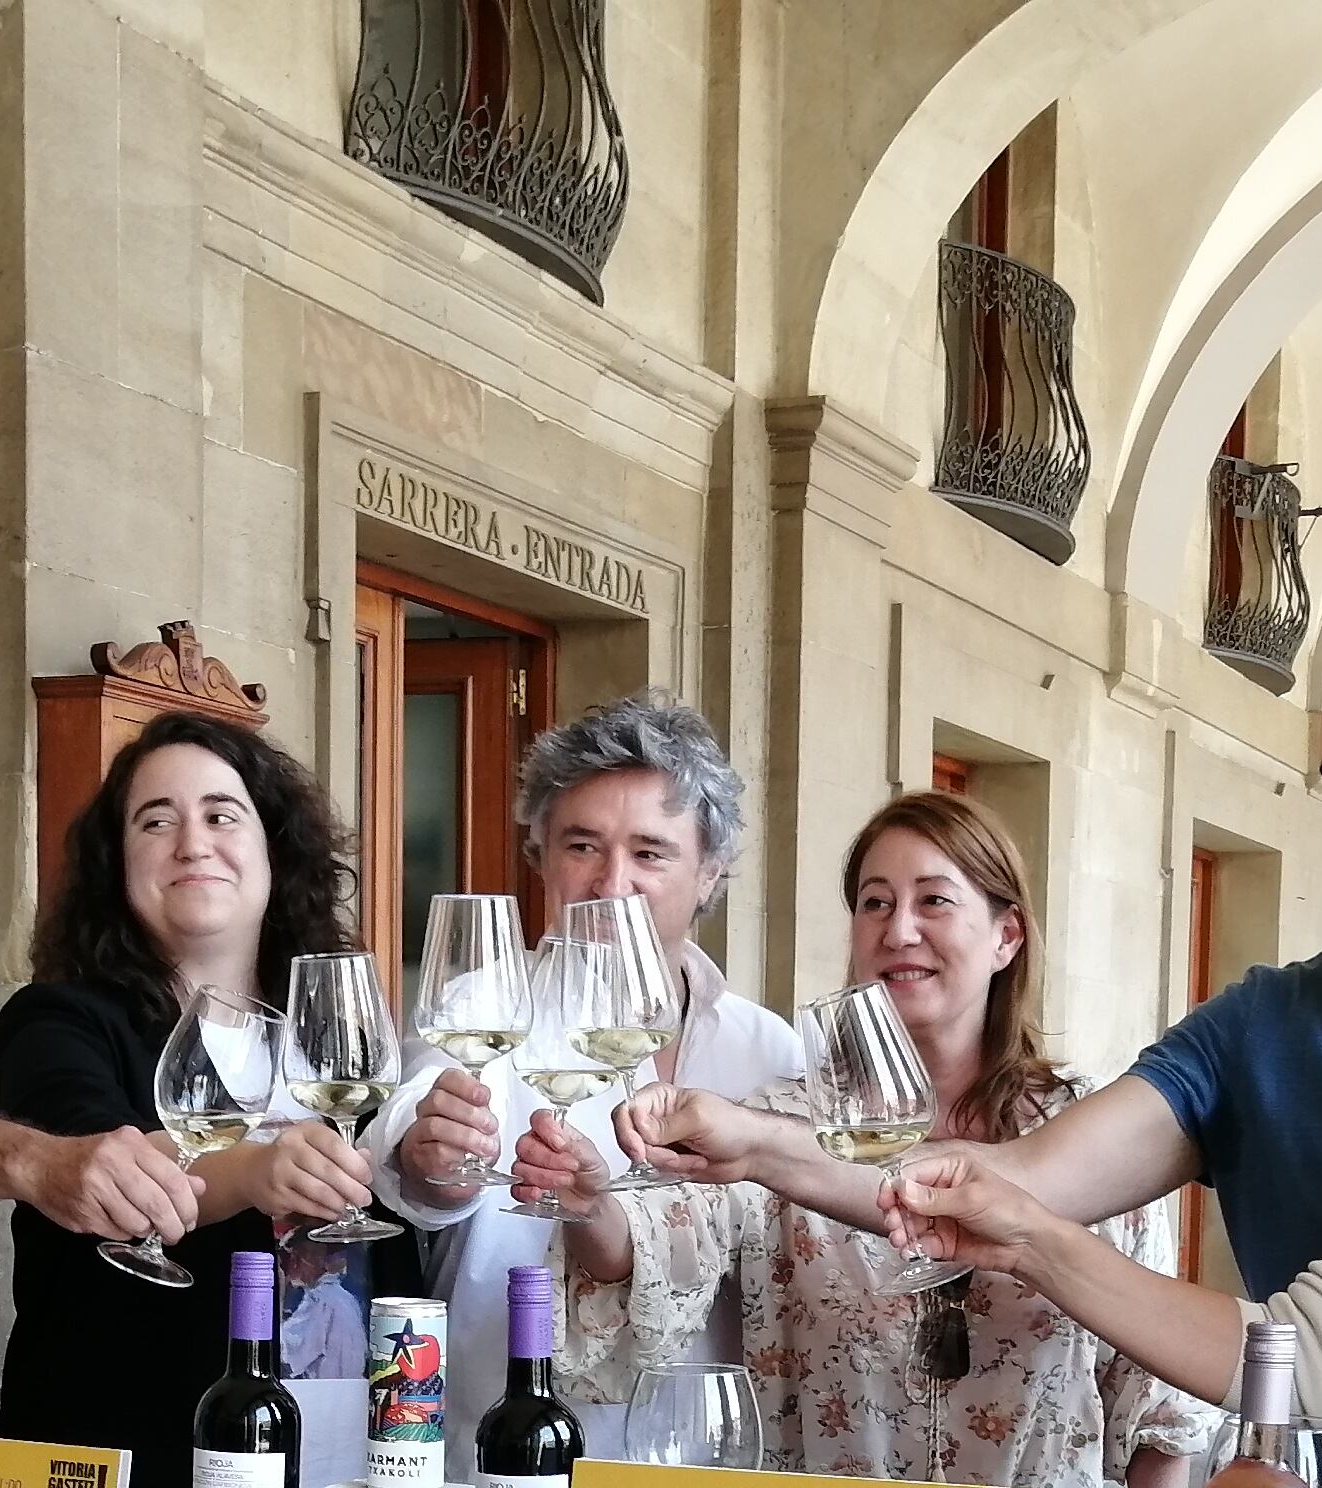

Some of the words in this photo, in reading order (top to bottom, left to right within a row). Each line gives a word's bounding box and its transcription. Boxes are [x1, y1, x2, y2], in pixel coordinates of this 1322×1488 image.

[356, 458, 506, 561] SARRERA
[524, 524, 650, 614] ENTRADA
[50, 1460, 96, 1479] VITORIA
[367, 1465, 421, 1478] TXAKOLI
